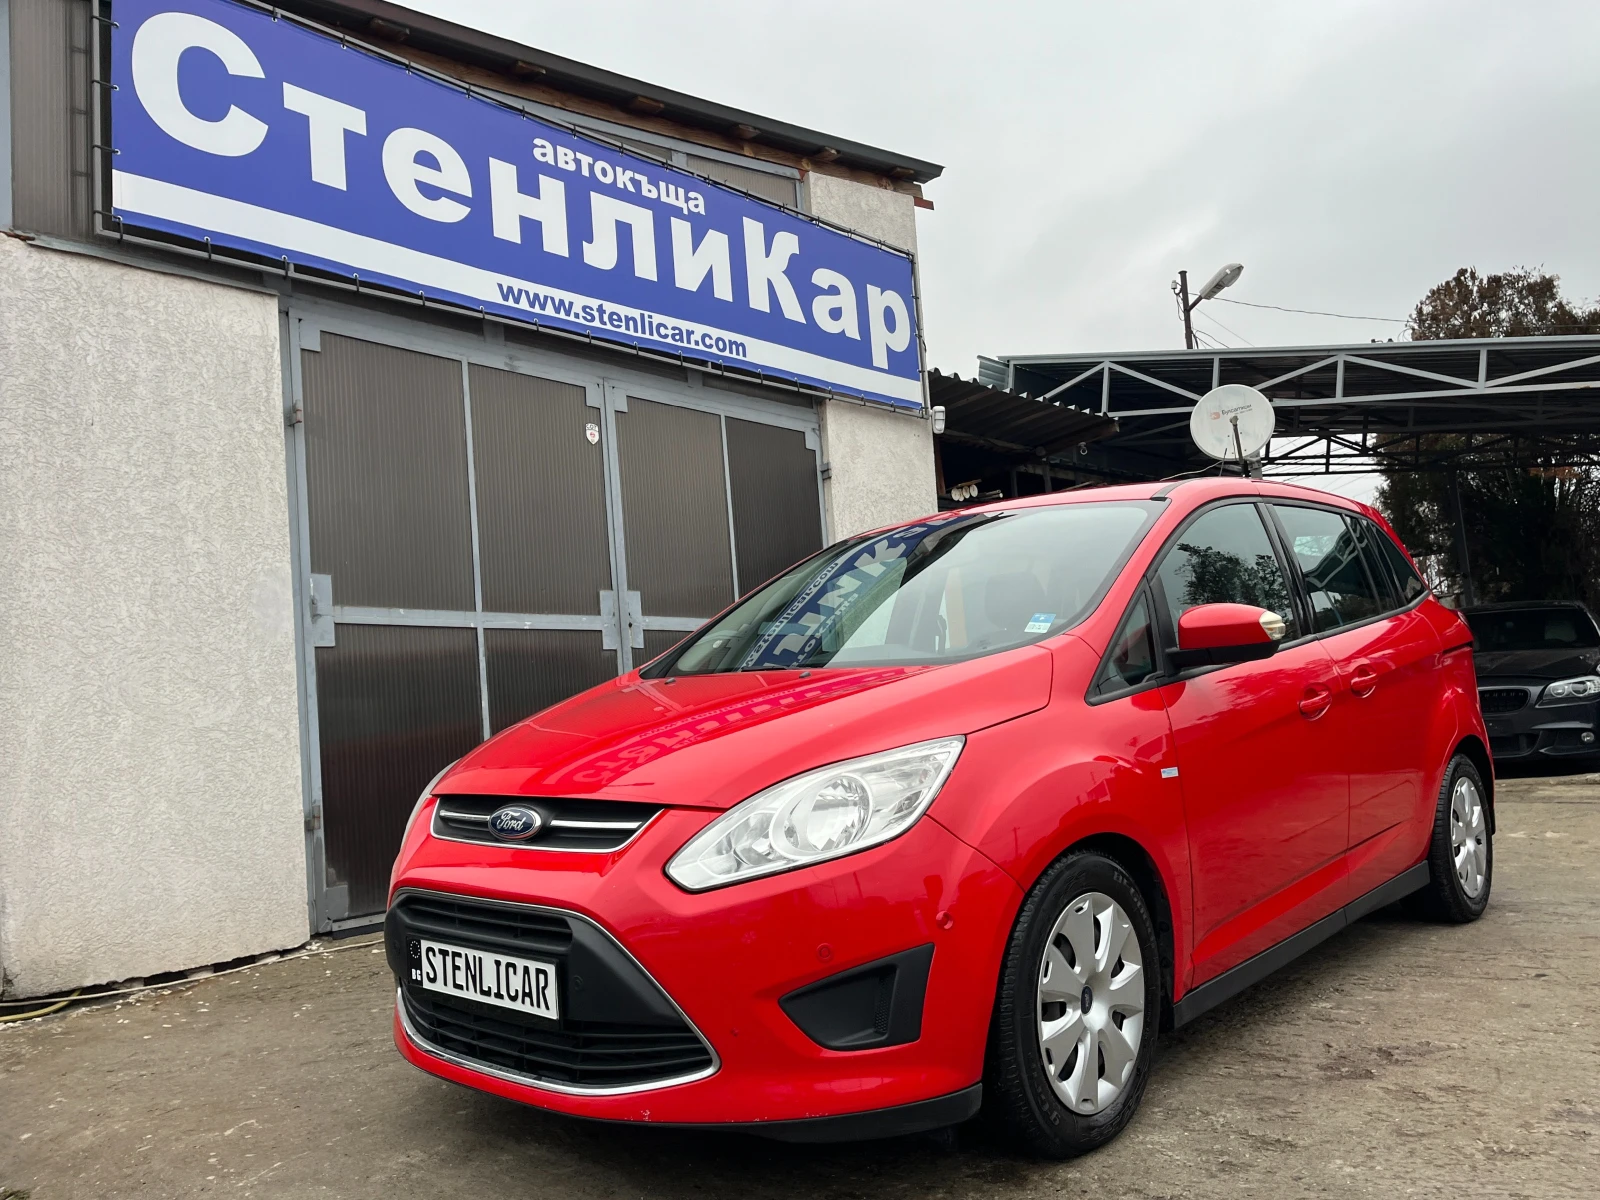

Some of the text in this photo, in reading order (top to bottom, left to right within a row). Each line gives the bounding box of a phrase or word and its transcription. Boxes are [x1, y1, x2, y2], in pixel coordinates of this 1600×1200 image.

[131, 11, 911, 370] СтенлиКар
[532, 137, 706, 216] автокъща
[496, 282, 748, 359] www.stenlicar.com
[496, 810, 527, 831] Ford
[411, 968, 422, 981] BG
[425, 946, 550, 1011] STENLICAR
